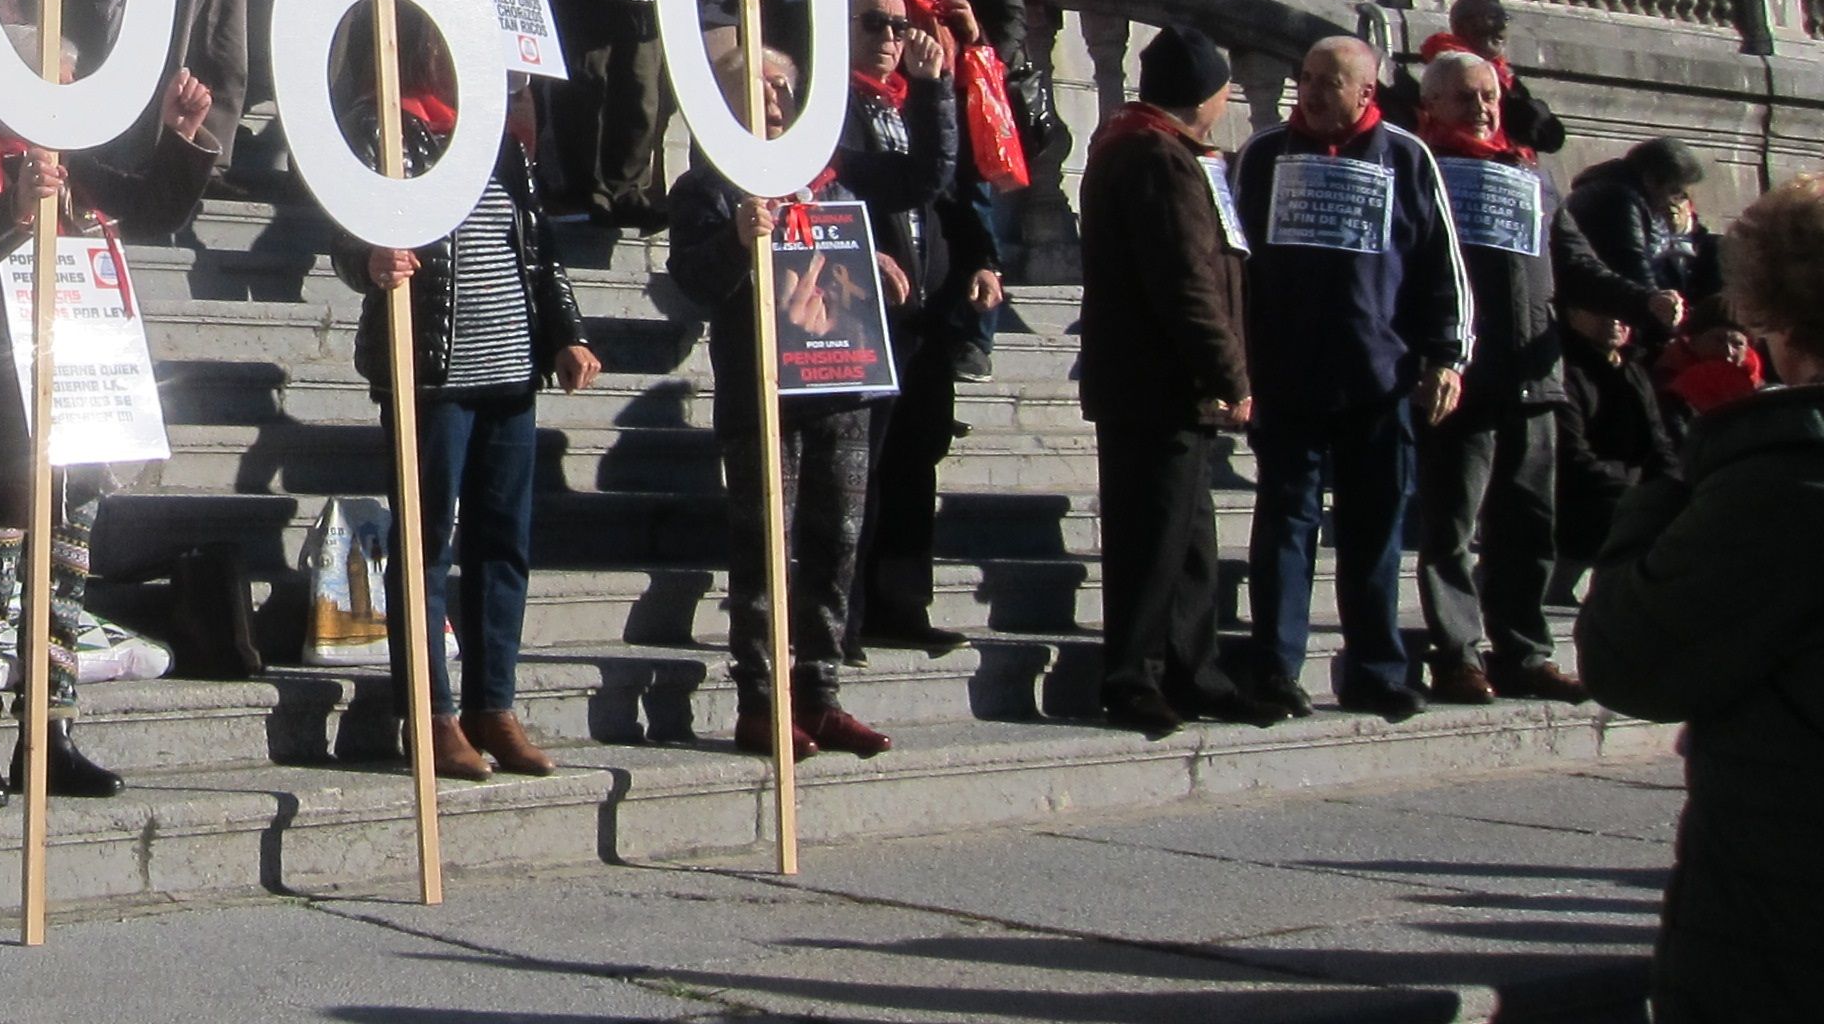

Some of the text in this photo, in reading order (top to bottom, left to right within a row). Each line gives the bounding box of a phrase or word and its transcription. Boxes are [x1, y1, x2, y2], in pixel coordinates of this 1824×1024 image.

[1288, 200, 1363, 217] NO LLEGAR
[1293, 212, 1315, 223] FIN
[806, 339, 850, 349] POR UNAS
[783, 349, 878, 365] PENSIONES
[800, 366, 866, 381] DIGNAS
